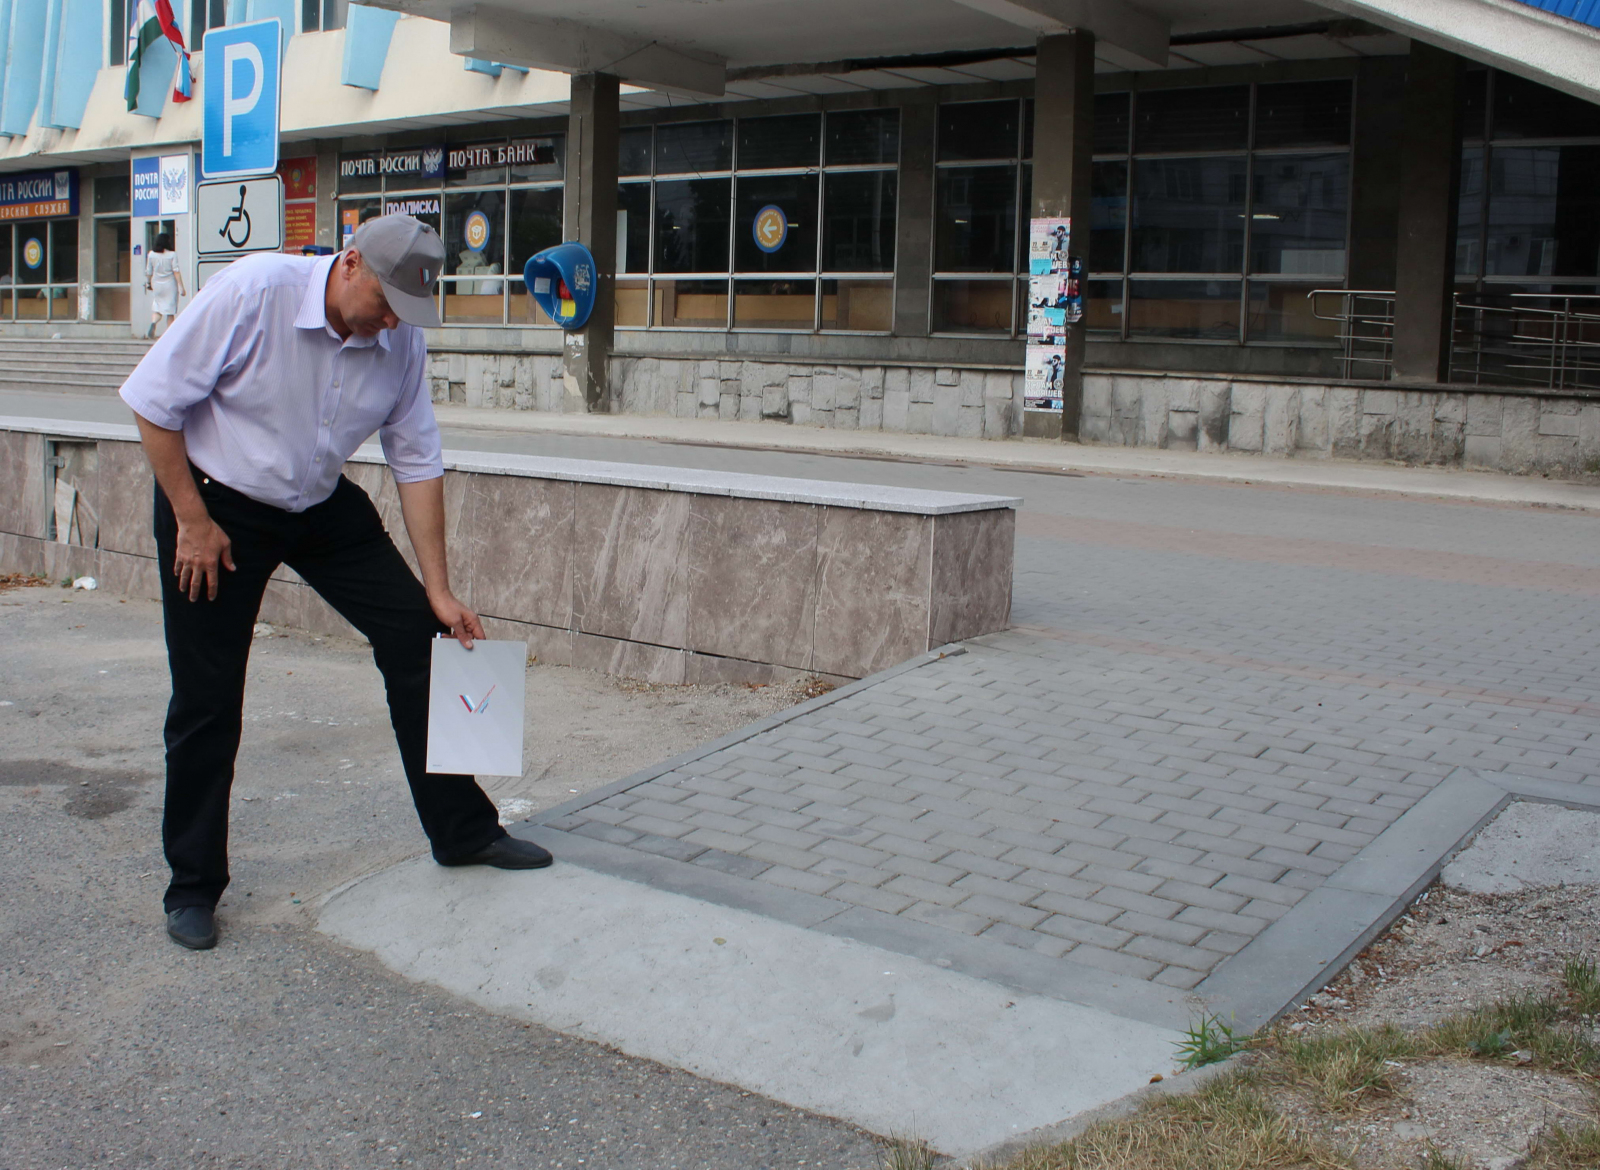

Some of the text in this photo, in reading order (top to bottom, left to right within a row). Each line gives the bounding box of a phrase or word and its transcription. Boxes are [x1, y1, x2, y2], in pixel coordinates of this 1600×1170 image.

[223, 41, 264, 157] P
[449, 144, 535, 167] ПОЧТА БАНК
[341, 155, 420, 176] ПОЧТА РОССИИ
[134, 172, 159, 186] ПОЧТА
[17, 179, 52, 199] РОССИИ
[134, 187, 159, 201] РОССИИ
[34, 202, 67, 215] СЛУЖБА
[386, 199, 440, 216] ПОДПИСКА
